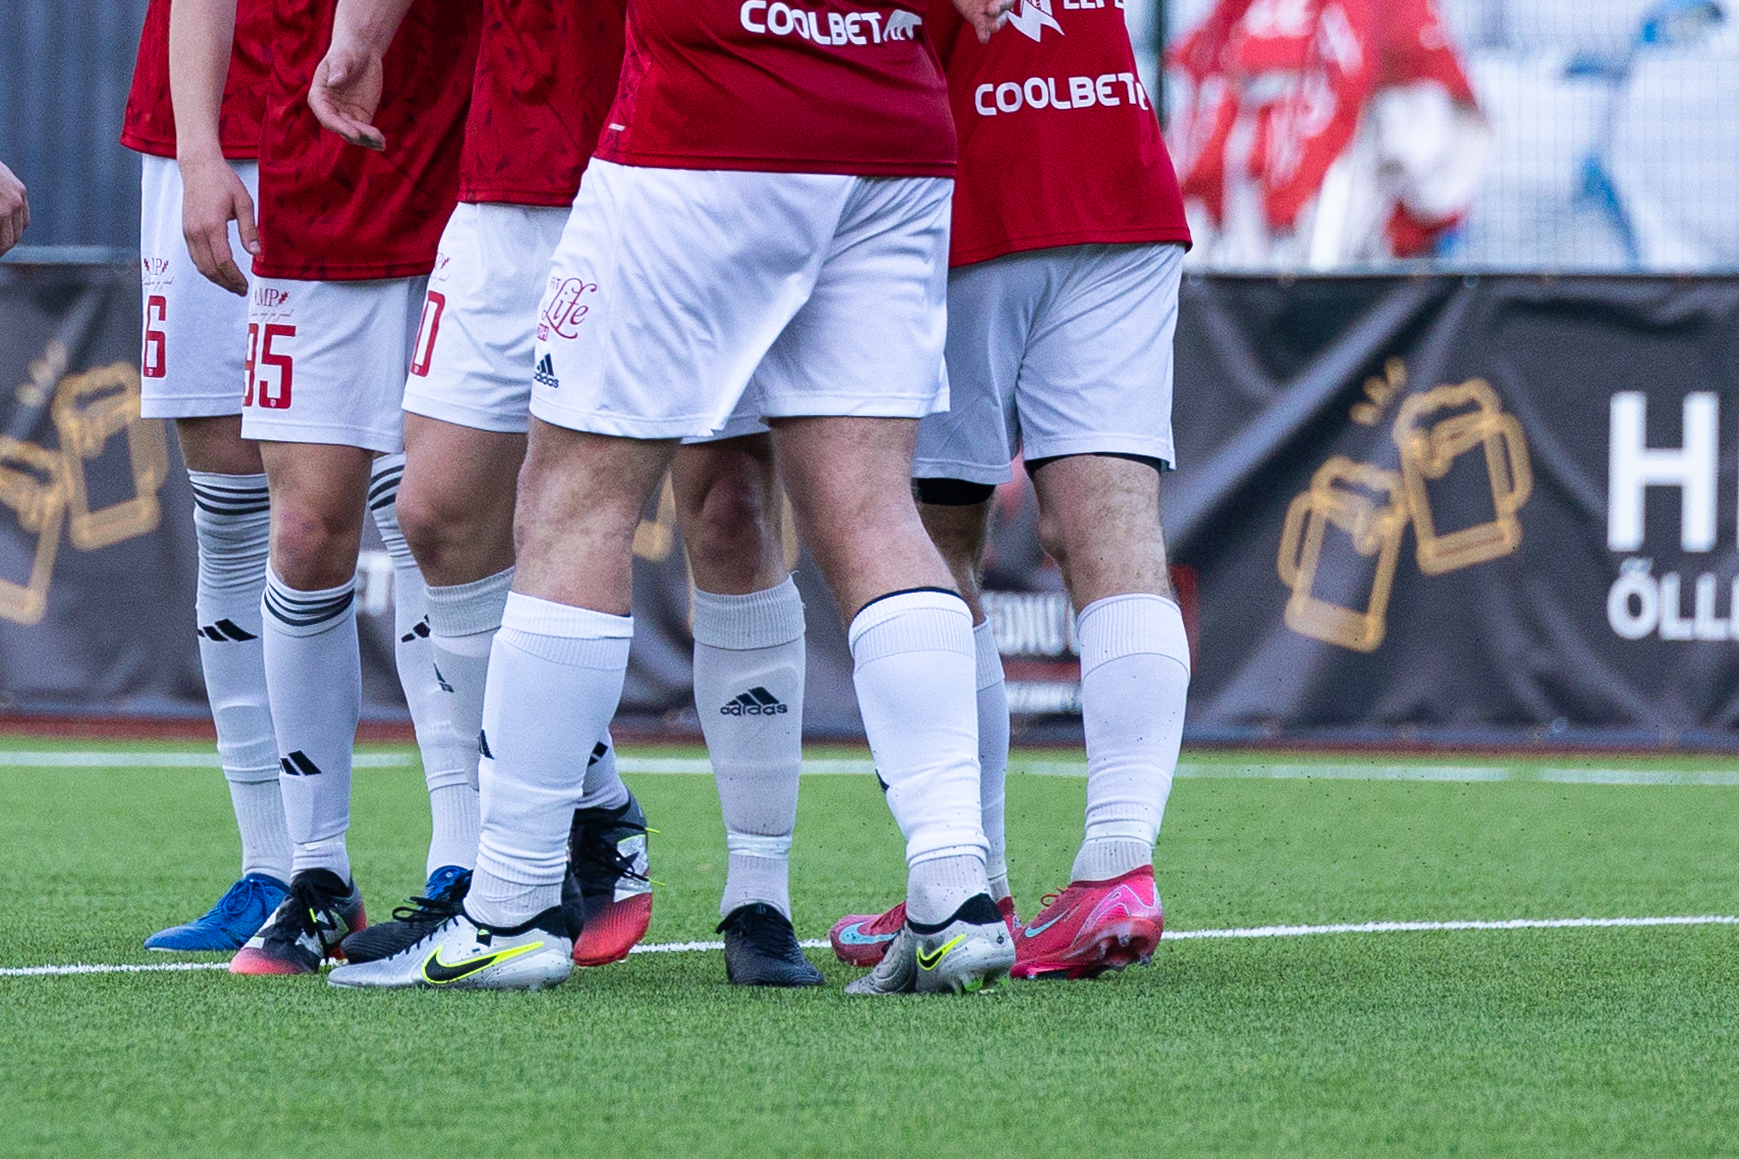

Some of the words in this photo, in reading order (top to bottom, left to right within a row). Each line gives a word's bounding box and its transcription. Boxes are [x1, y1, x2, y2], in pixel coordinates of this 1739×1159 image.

[740, 0, 882, 46] COOLBET
[975, 72, 1137, 116] COOLBET
[143, 295, 166, 378] 6
[1607, 556, 1739, 642] ÕLL
[720, 703, 788, 717] adidas
